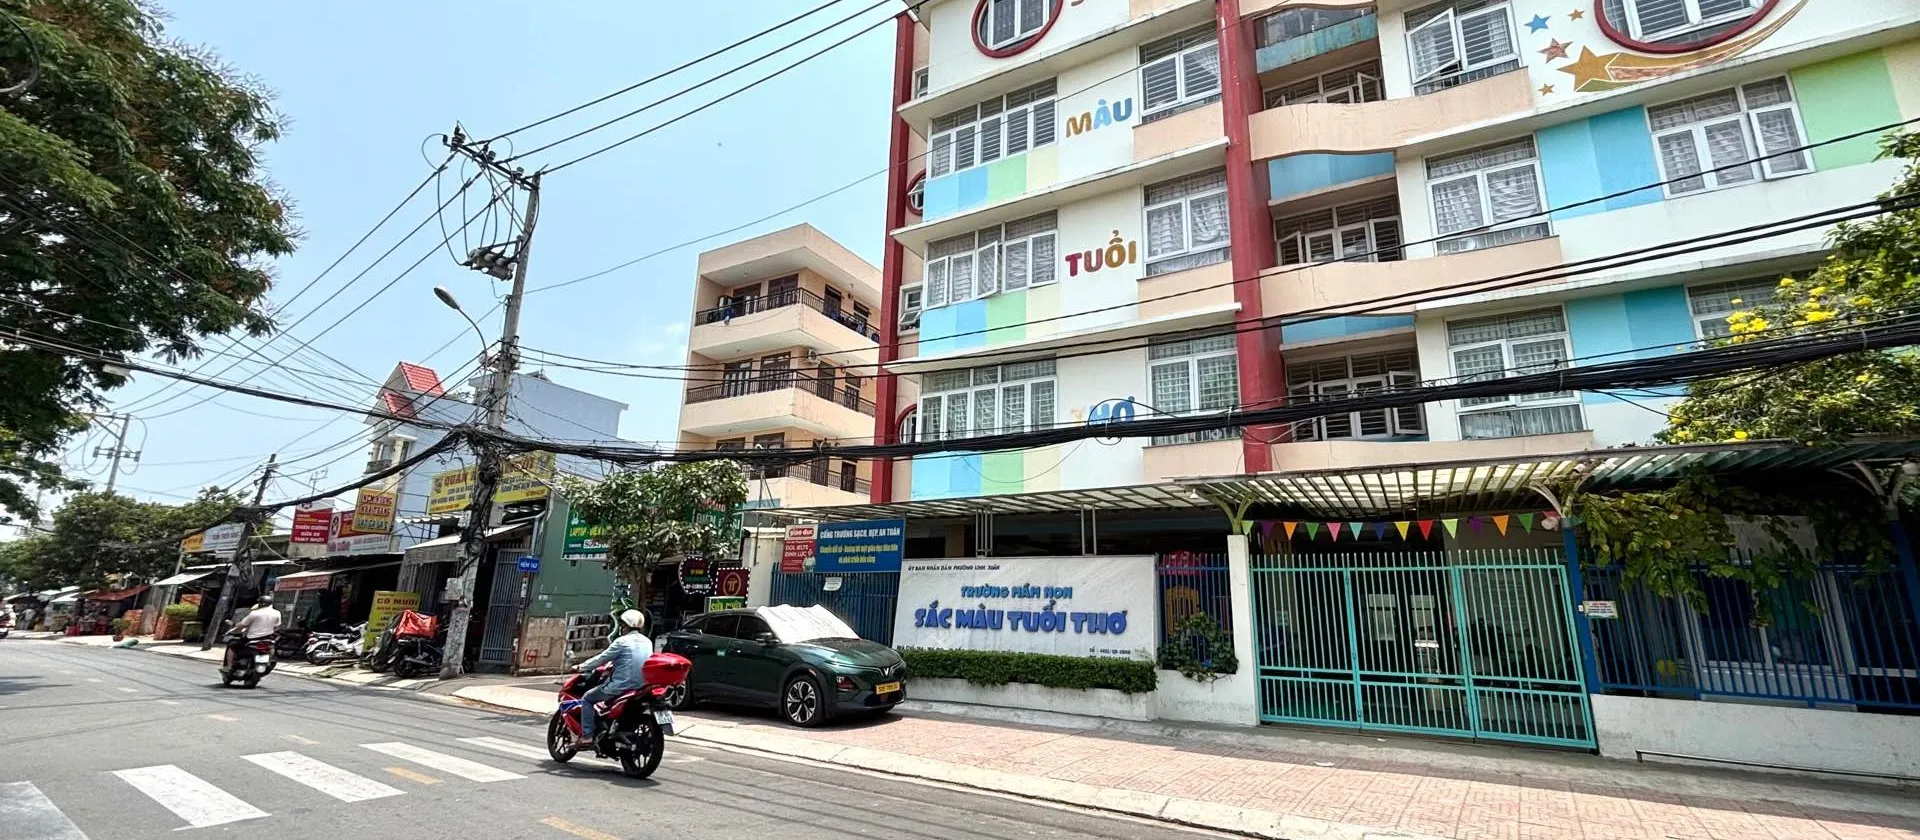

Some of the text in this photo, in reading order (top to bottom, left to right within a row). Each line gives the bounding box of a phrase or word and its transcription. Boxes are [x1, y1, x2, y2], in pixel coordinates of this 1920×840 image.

[1066, 97, 1132, 138] MÀU
[1065, 229, 1137, 277] TUỔI
[820, 529, 833, 539] CỔNG
[834, 529, 853, 538] TRƯỜNG
[879, 529, 886, 537] AN
[887, 527, 901, 537] TOÀN
[987, 563, 1000, 571] XUÂN
[961, 582, 1073, 599] TRƯỜNG MẦM NON
[915, 600, 1128, 635] SẮC MÀU TUỔI THƠ
